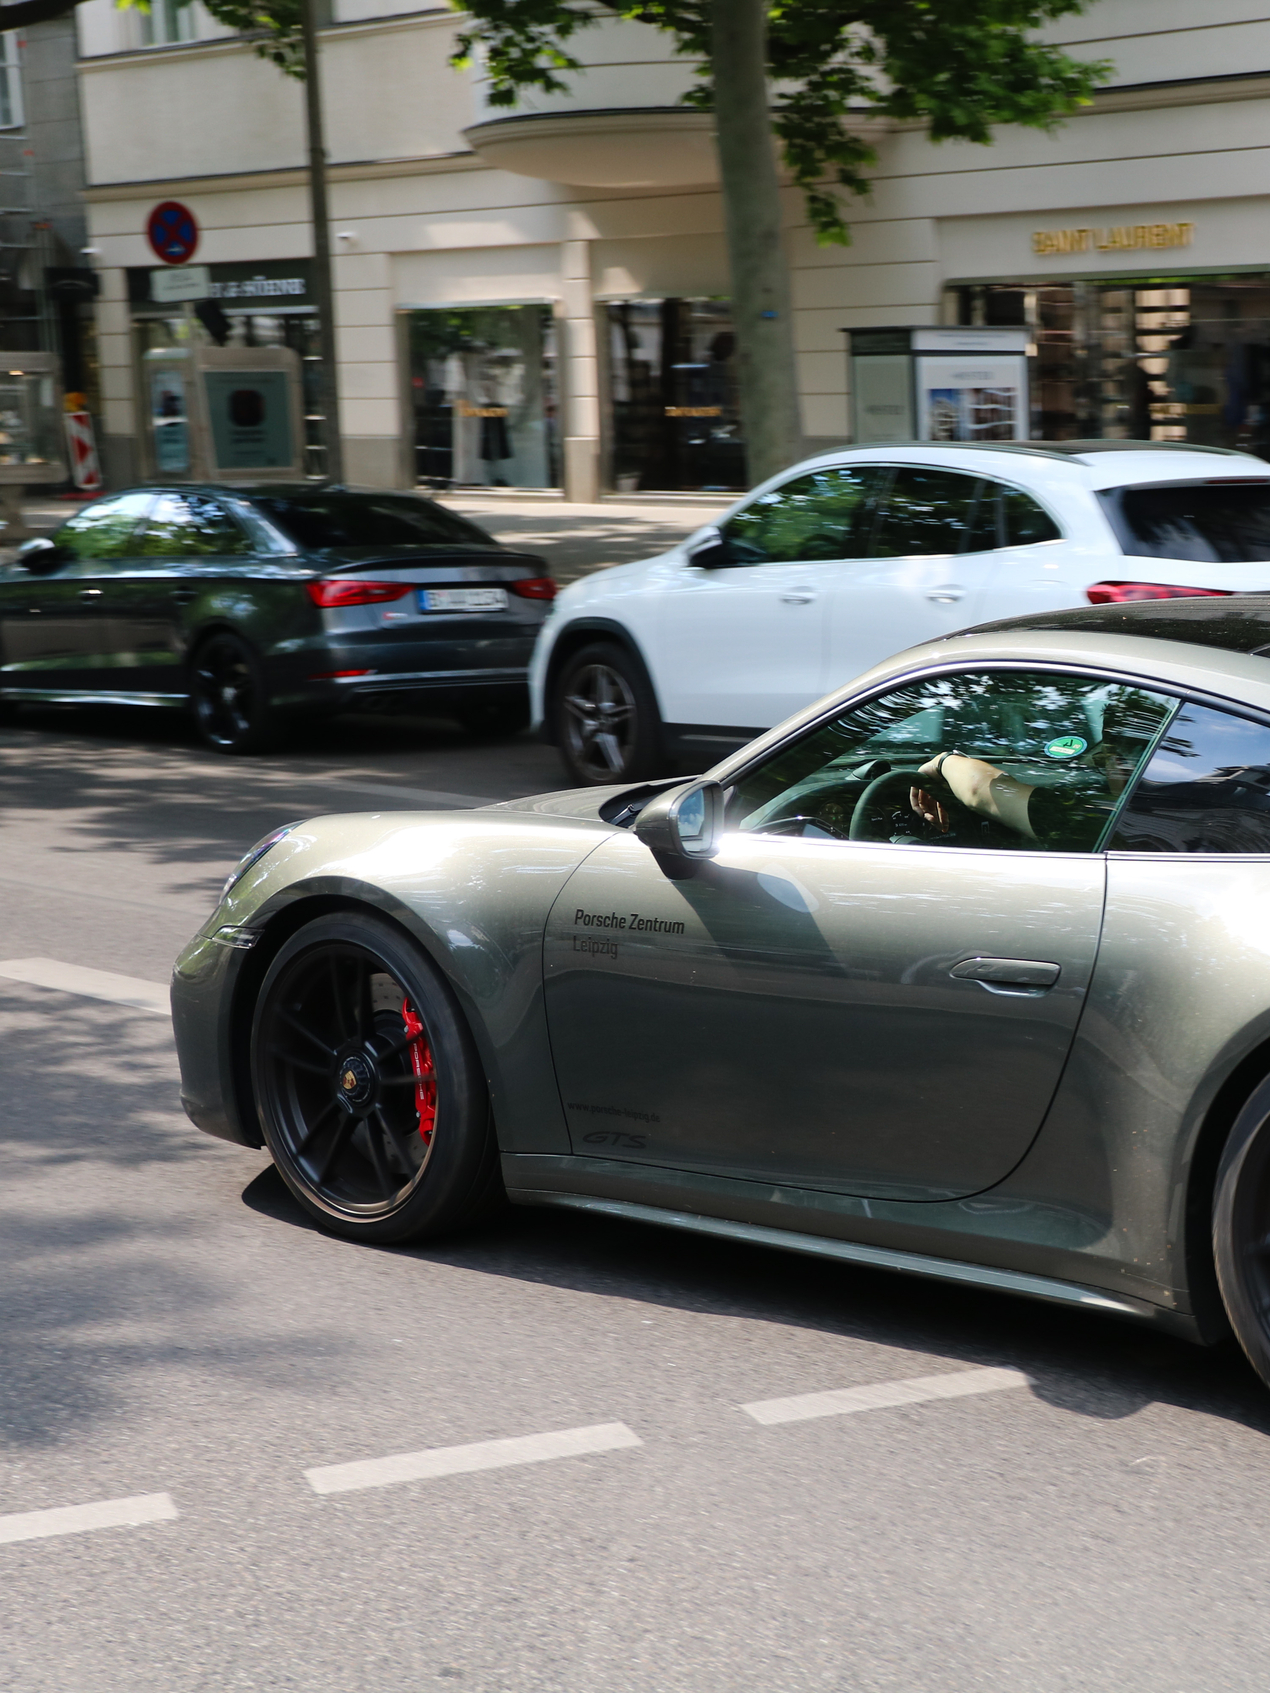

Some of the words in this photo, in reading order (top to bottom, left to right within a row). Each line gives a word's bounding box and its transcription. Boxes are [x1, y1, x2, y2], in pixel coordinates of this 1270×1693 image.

[1032, 229, 1089, 254] SAINT
[1095, 223, 1195, 251] LAURENT
[575, 909, 627, 930] Porsche
[628, 913, 685, 935] Zentrum
[573, 936, 619, 960] Leipzig
[567, 1102, 661, 1123] www.porsche-leipzig.de
[582, 1130, 647, 1149] GTS
